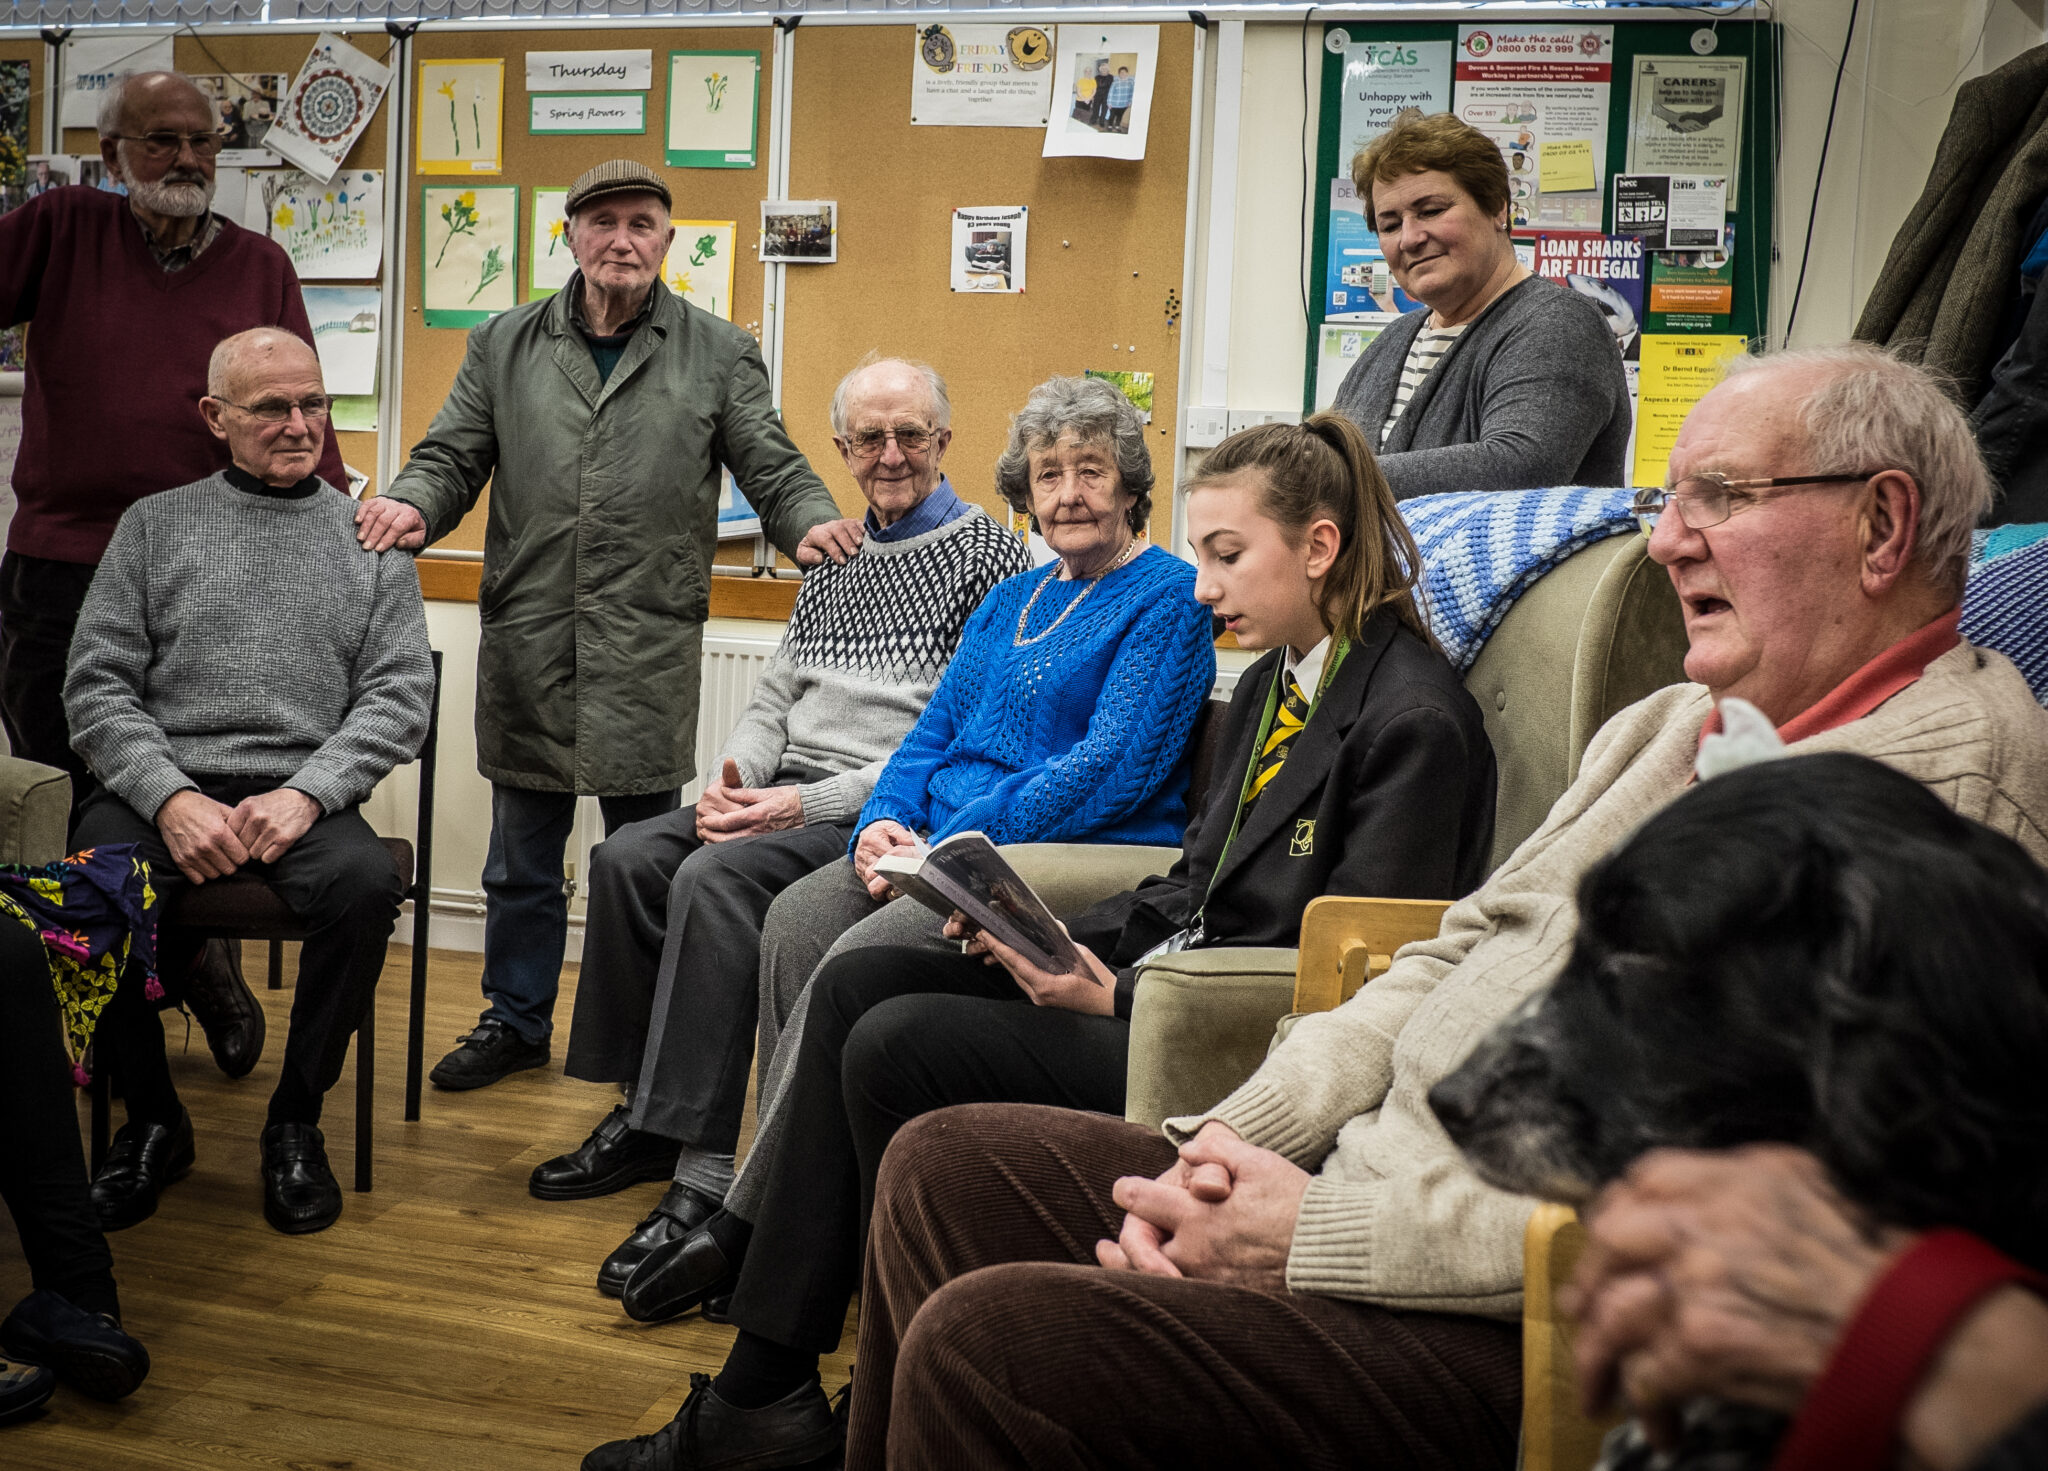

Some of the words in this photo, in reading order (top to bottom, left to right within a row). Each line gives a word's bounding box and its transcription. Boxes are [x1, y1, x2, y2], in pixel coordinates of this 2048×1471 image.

[1497, 35, 1525, 43] Make
[1550, 35, 1574, 43] call!
[960, 45, 1006, 55] FRIDAY
[1555, 45, 1573, 53] 999
[549, 63, 626, 79] Thursday
[957, 64, 1008, 73] FRIENDS
[1663, 78, 1717, 86] CARERS
[1360, 91, 1406, 103] Unhappy
[1410, 91, 1432, 100] with
[550, 108, 584, 119] Spring
[588, 108, 625, 119] flowers
[1369, 107, 1392, 117] your
[1540, 240, 1578, 257] LOAN
[1583, 240, 1642, 258] SHARKS
[1576, 260, 1640, 280] ILLEGAL
